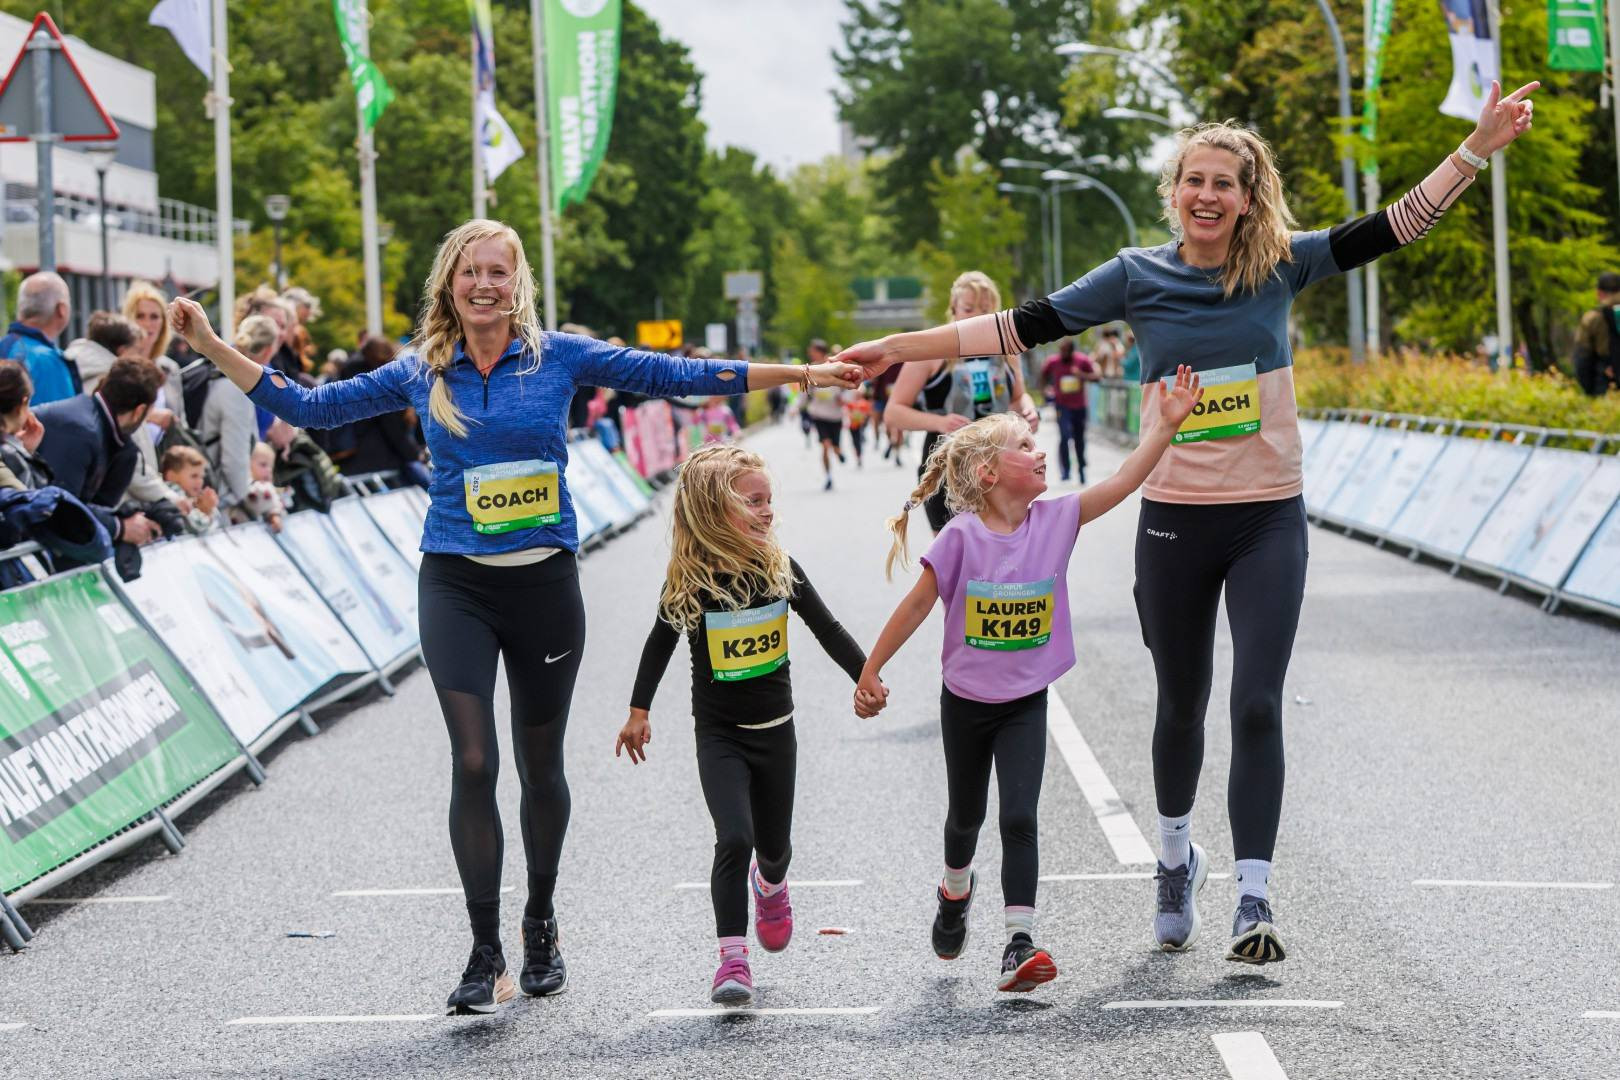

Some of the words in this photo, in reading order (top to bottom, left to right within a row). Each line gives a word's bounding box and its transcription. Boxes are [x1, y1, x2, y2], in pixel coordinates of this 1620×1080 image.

[1192, 394, 1250, 416] OACH
[477, 487, 548, 510] COACH
[1146, 528, 1170, 539] CRAFT
[976, 599, 1047, 616] LAUREN
[982, 617, 1041, 638] K149
[722, 630, 781, 659] K239
